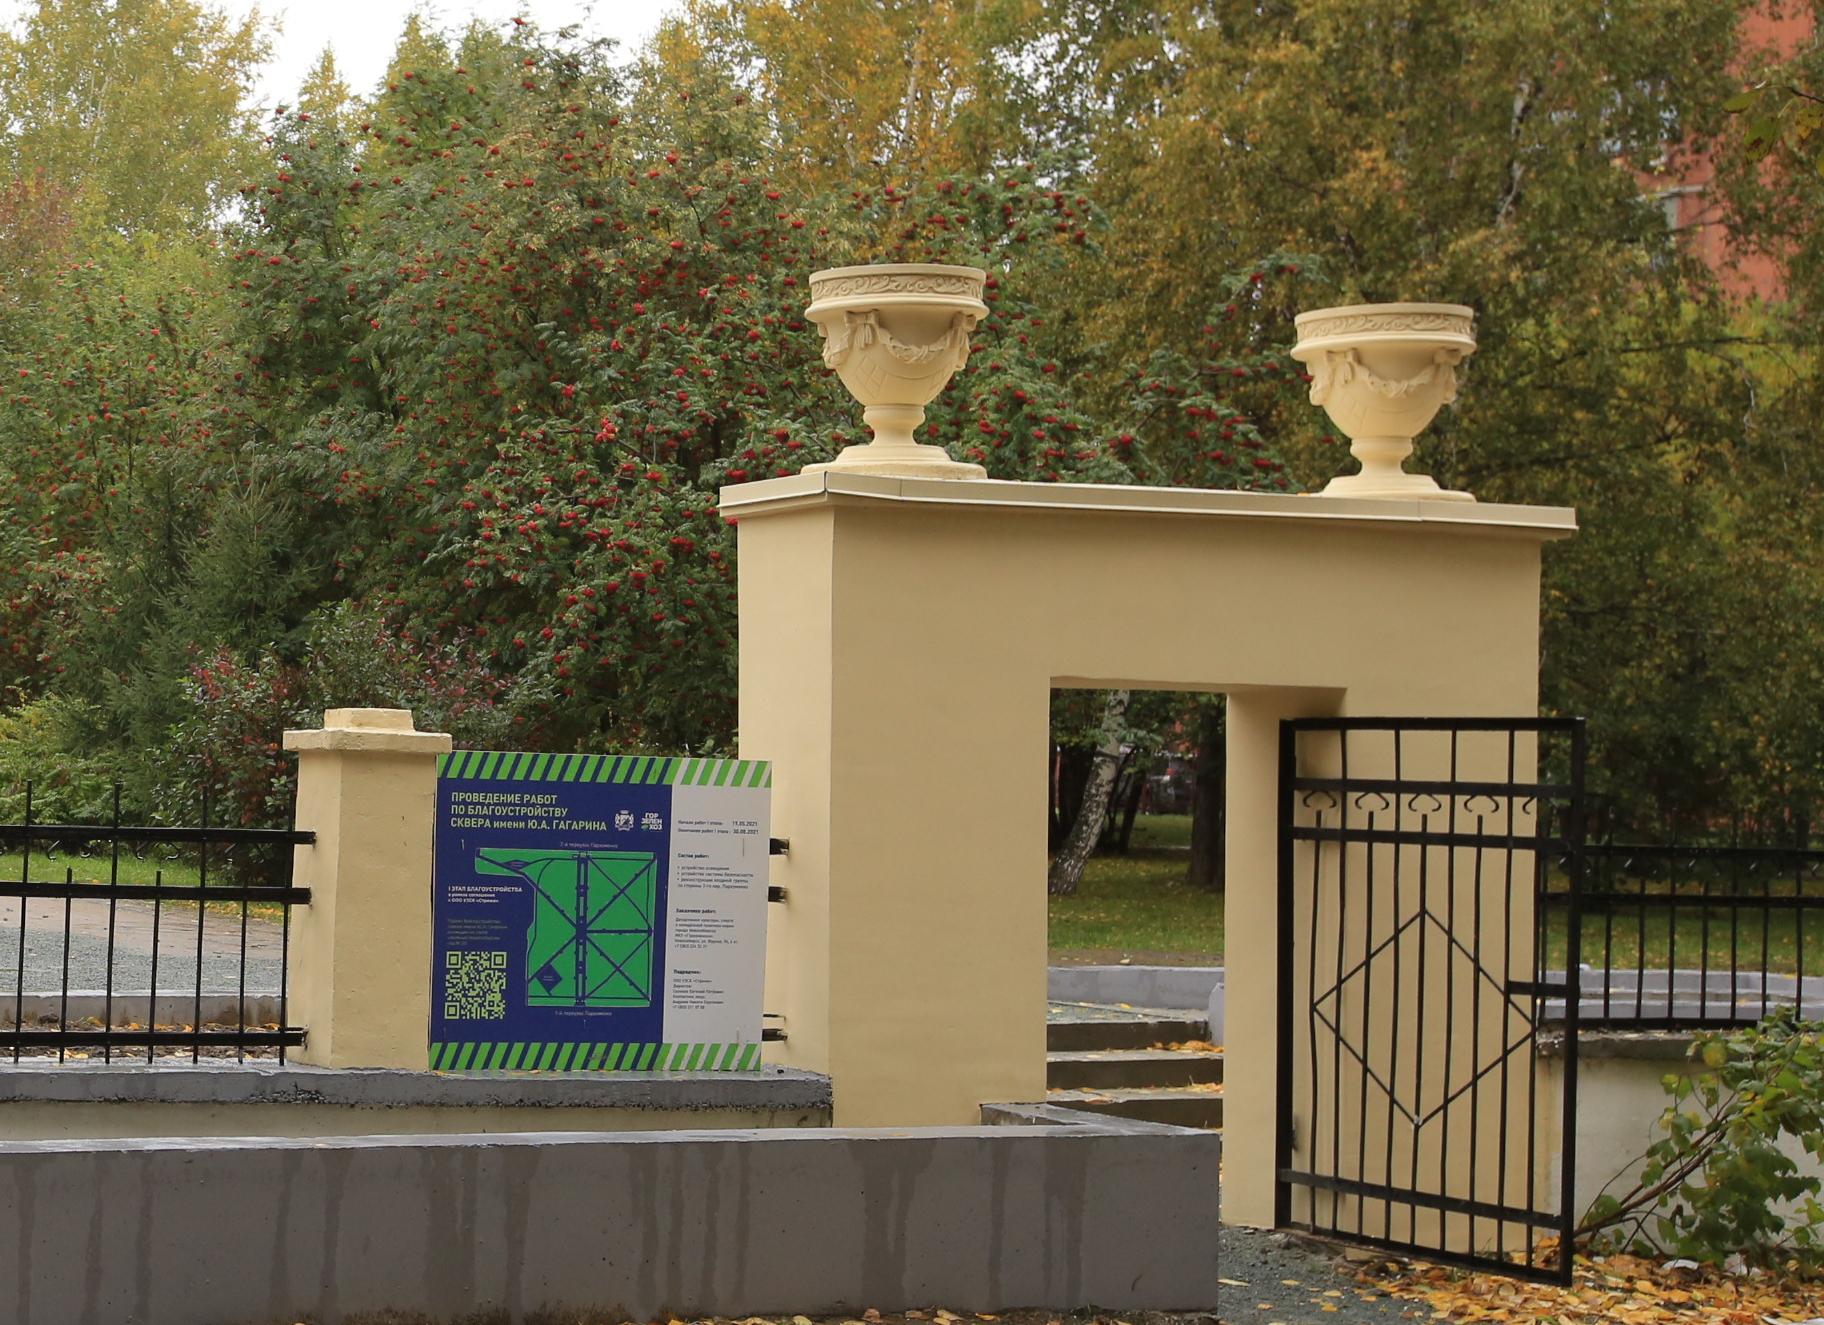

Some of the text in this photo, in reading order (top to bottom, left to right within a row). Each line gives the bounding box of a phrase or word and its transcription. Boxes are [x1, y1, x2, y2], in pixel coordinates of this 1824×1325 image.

[451, 792, 558, 804] ПРОВЕДЕНИЕ РАБОТ
[451, 805, 569, 817] ПО БЛАГОУСТРОЙСТВУ
[450, 817, 607, 831] СКВЕРА имени Ю.А. ГАГАРИНА
